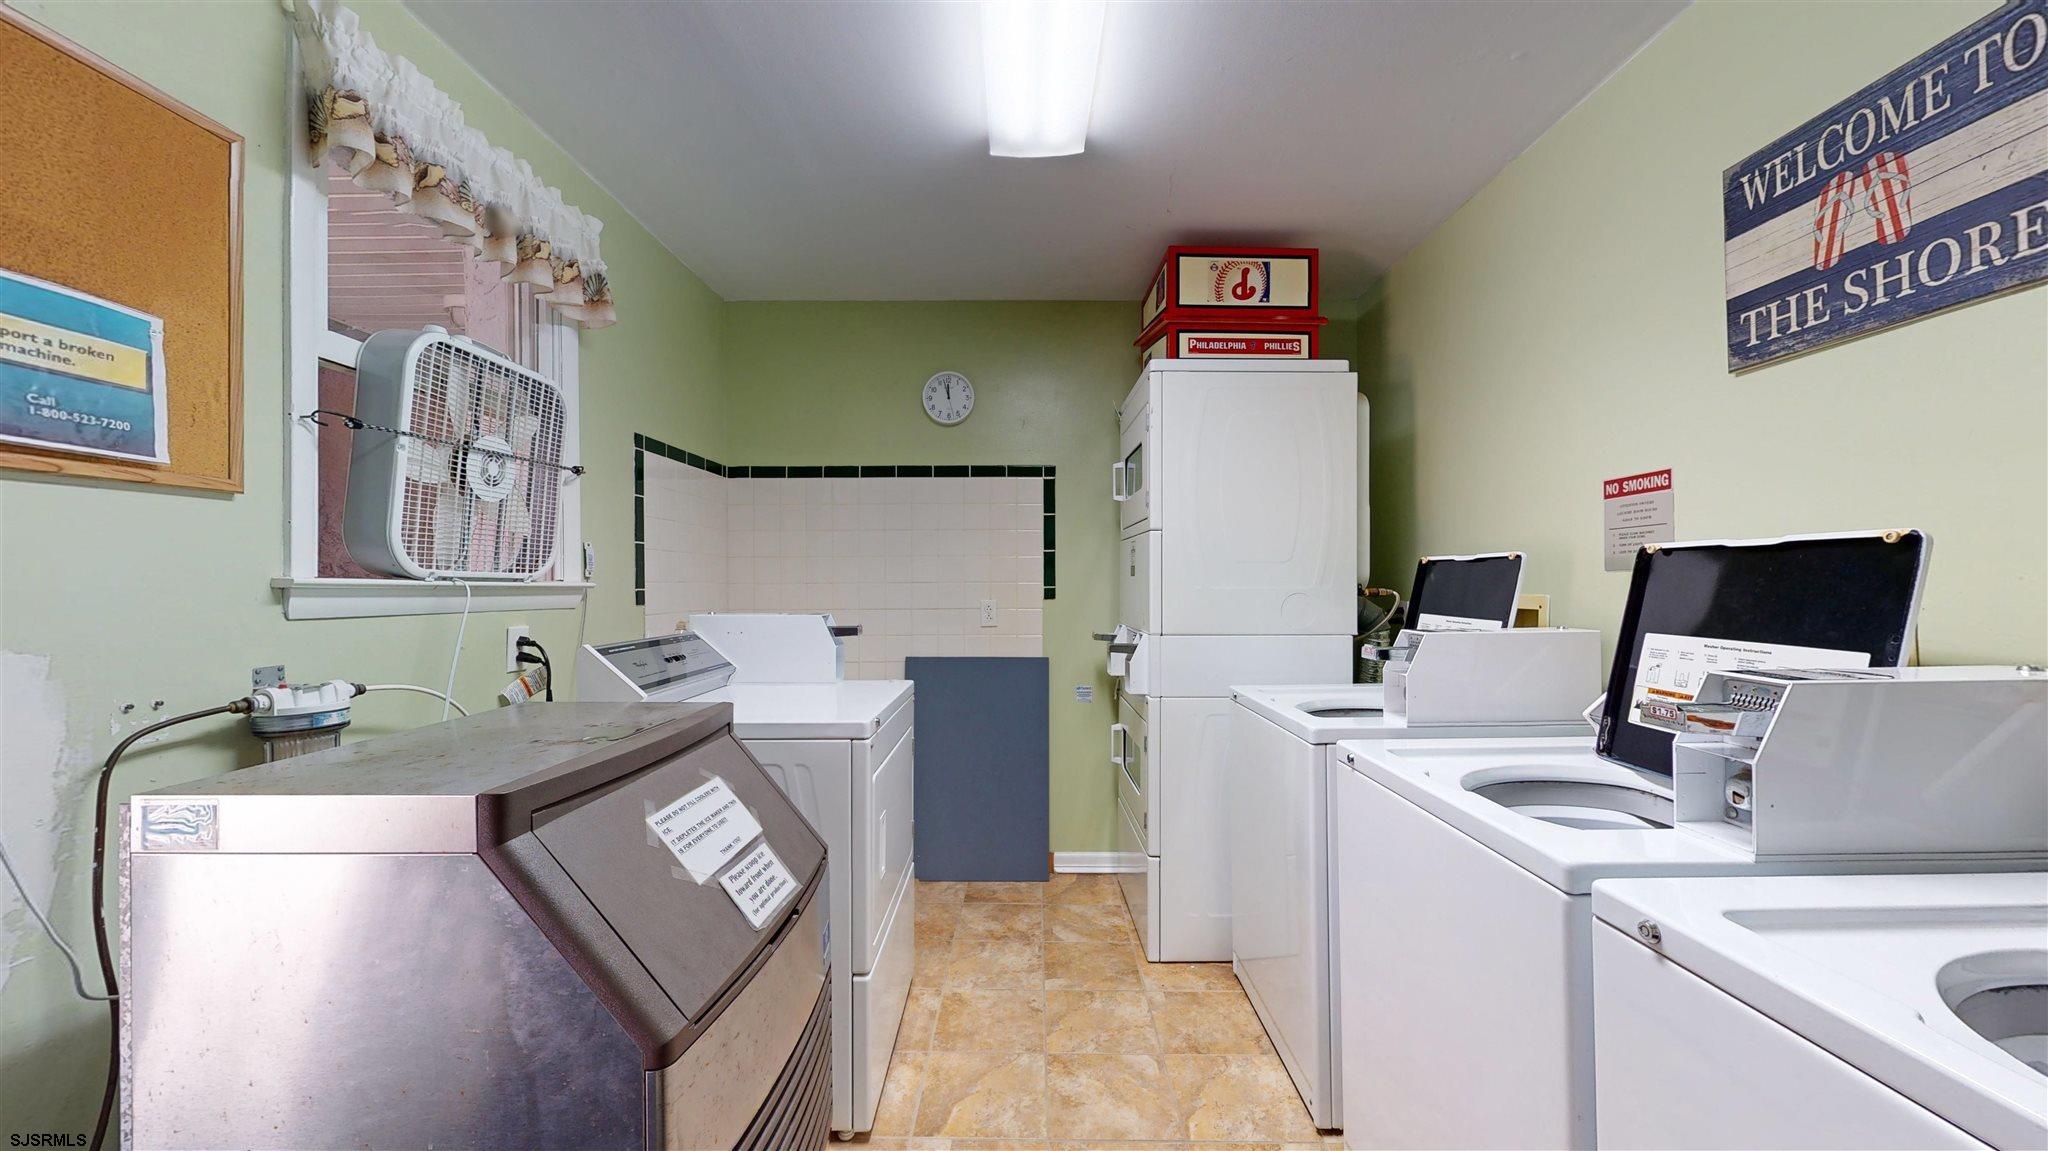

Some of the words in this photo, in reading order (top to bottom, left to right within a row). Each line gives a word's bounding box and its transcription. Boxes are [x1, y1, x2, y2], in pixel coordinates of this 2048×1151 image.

[1740, 63, 1951, 211] WELCOME
[1963, 12, 2047, 94] TO
[1740, 283, 1831, 348] THE
[1843, 204, 2048, 316] SHORE
[0, 341, 76, 366] machine.
[43, 337, 53, 347] a
[58, 334, 115, 362] broken
[26, 392, 56, 406] Call
[29, 405, 131, 432] 1-800-523-7200
[1605, 483, 1619, 496] NO
[1622, 474, 1669, 493] SMOKING
[1652, 706, 1674, 718] $1.75
[655, 814, 673, 827] PLEASE
[676, 826, 697, 842] DEPLETES
[710, 809, 722, 817] MAKER
[683, 841, 693, 850] FOR
[692, 827, 712, 843] EVERYONE
[720, 844, 732, 855] THANK
[728, 868, 745, 883] Please
[744, 857, 758, 870] scoop
[735, 878, 753, 896] toward
[750, 869, 763, 882] front
[762, 860, 774, 872] when
[749, 892, 759, 904] you
[758, 885, 766, 894] are
[765, 875, 778, 887] done.
